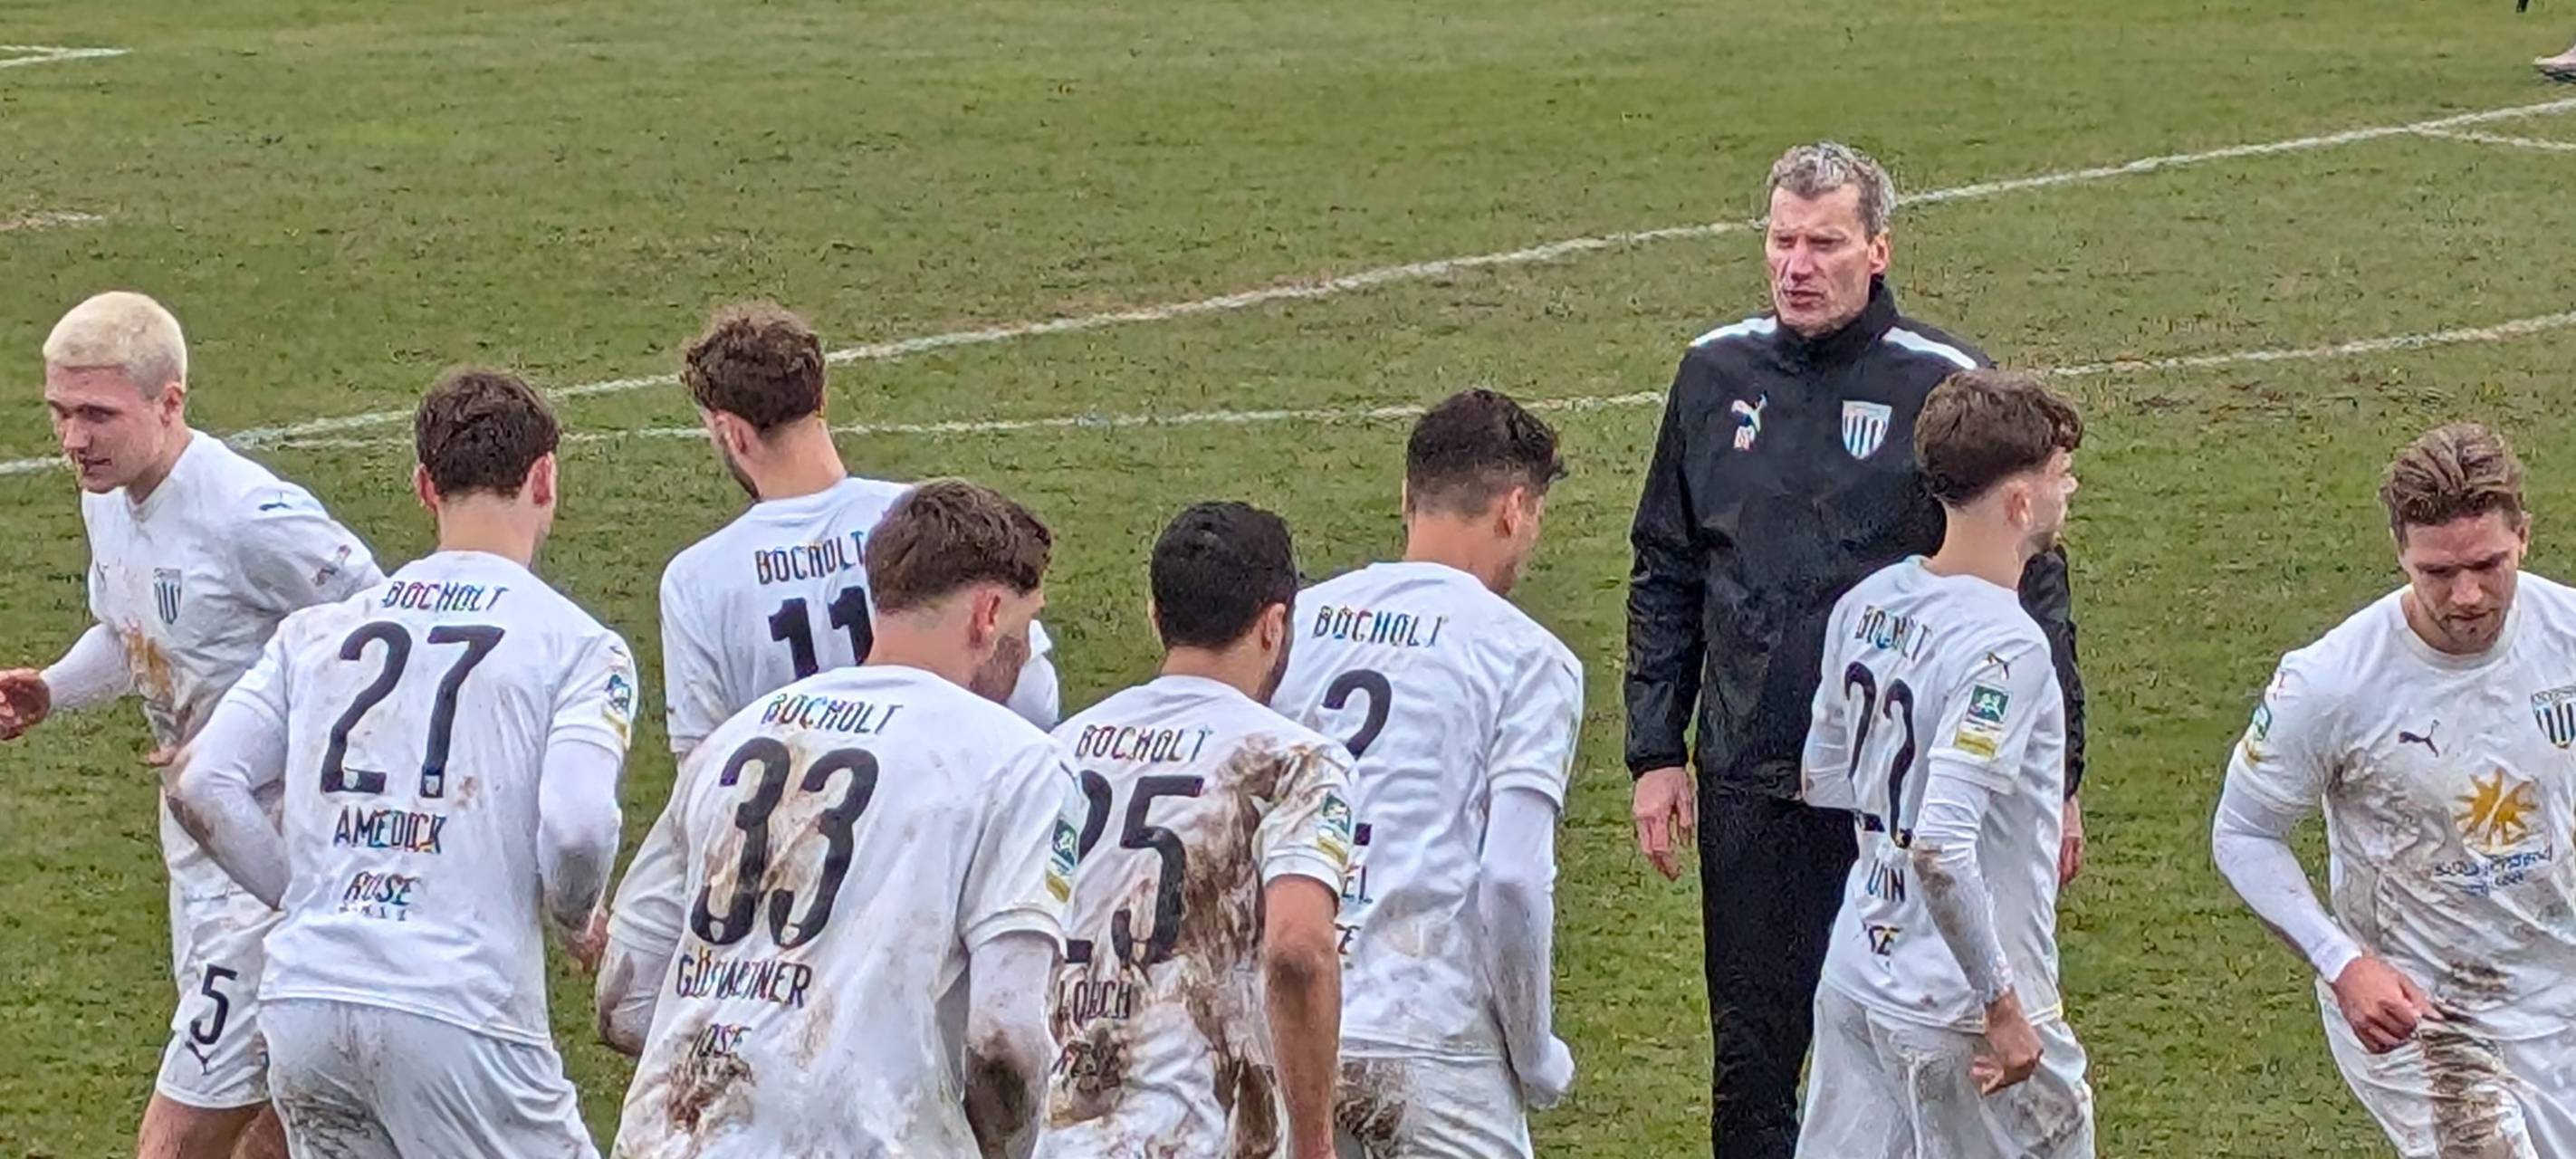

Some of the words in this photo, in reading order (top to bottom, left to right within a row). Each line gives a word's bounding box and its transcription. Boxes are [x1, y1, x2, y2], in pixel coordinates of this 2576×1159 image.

[754, 531, 865, 585] BOCHOLT
[380, 580, 510, 613] BOCHOLT
[768, 585, 875, 681] 11
[1312, 606, 1449, 648] BOCHOLT
[321, 622, 505, 799] 27
[761, 693, 904, 735] BOCHOLT
[1075, 723, 1212, 763] BOCHOLT
[690, 736, 879, 950] 33
[189, 964, 238, 1045] 5
